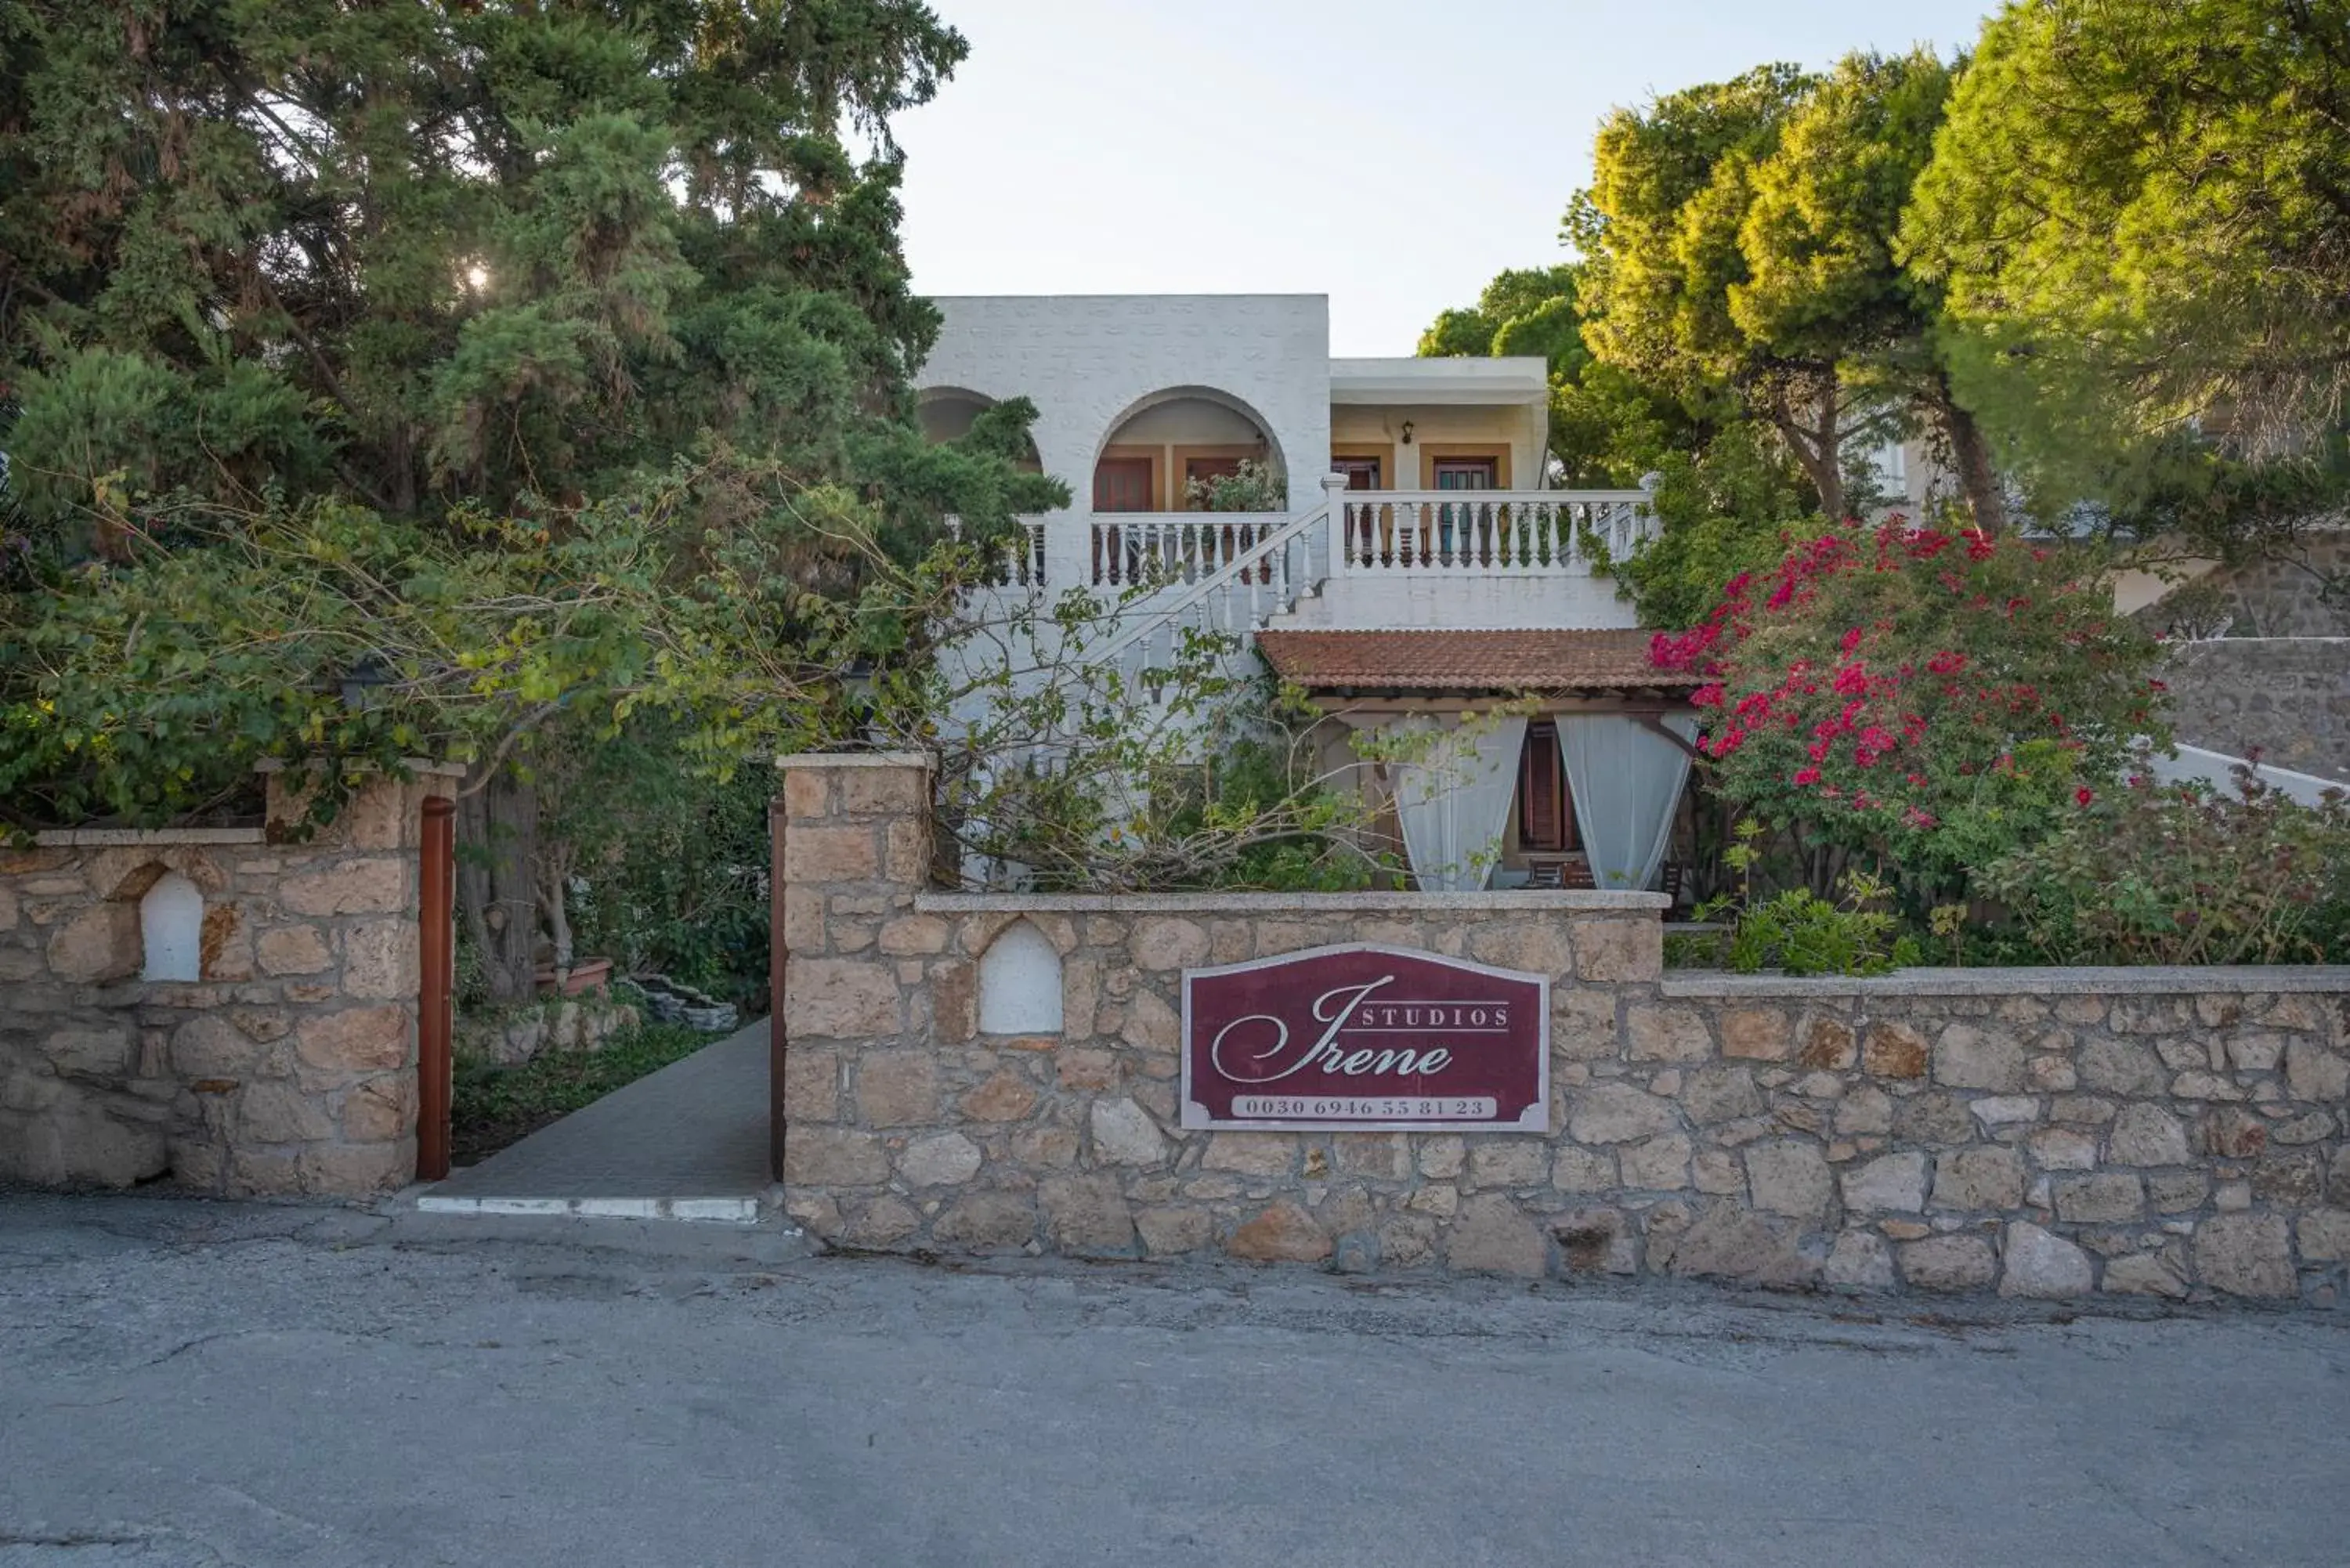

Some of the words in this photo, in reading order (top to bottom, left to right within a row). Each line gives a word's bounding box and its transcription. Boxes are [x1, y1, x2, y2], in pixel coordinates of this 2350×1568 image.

[1361, 1008, 1509, 1027] STUDIOS
[1211, 974, 1453, 1084] Irene
[1246, 1100, 1305, 1115] 0030
[1381, 1100, 1410, 1115] 55
[1419, 1100, 1444, 1115] 81
[1455, 1100, 1484, 1115] 23
